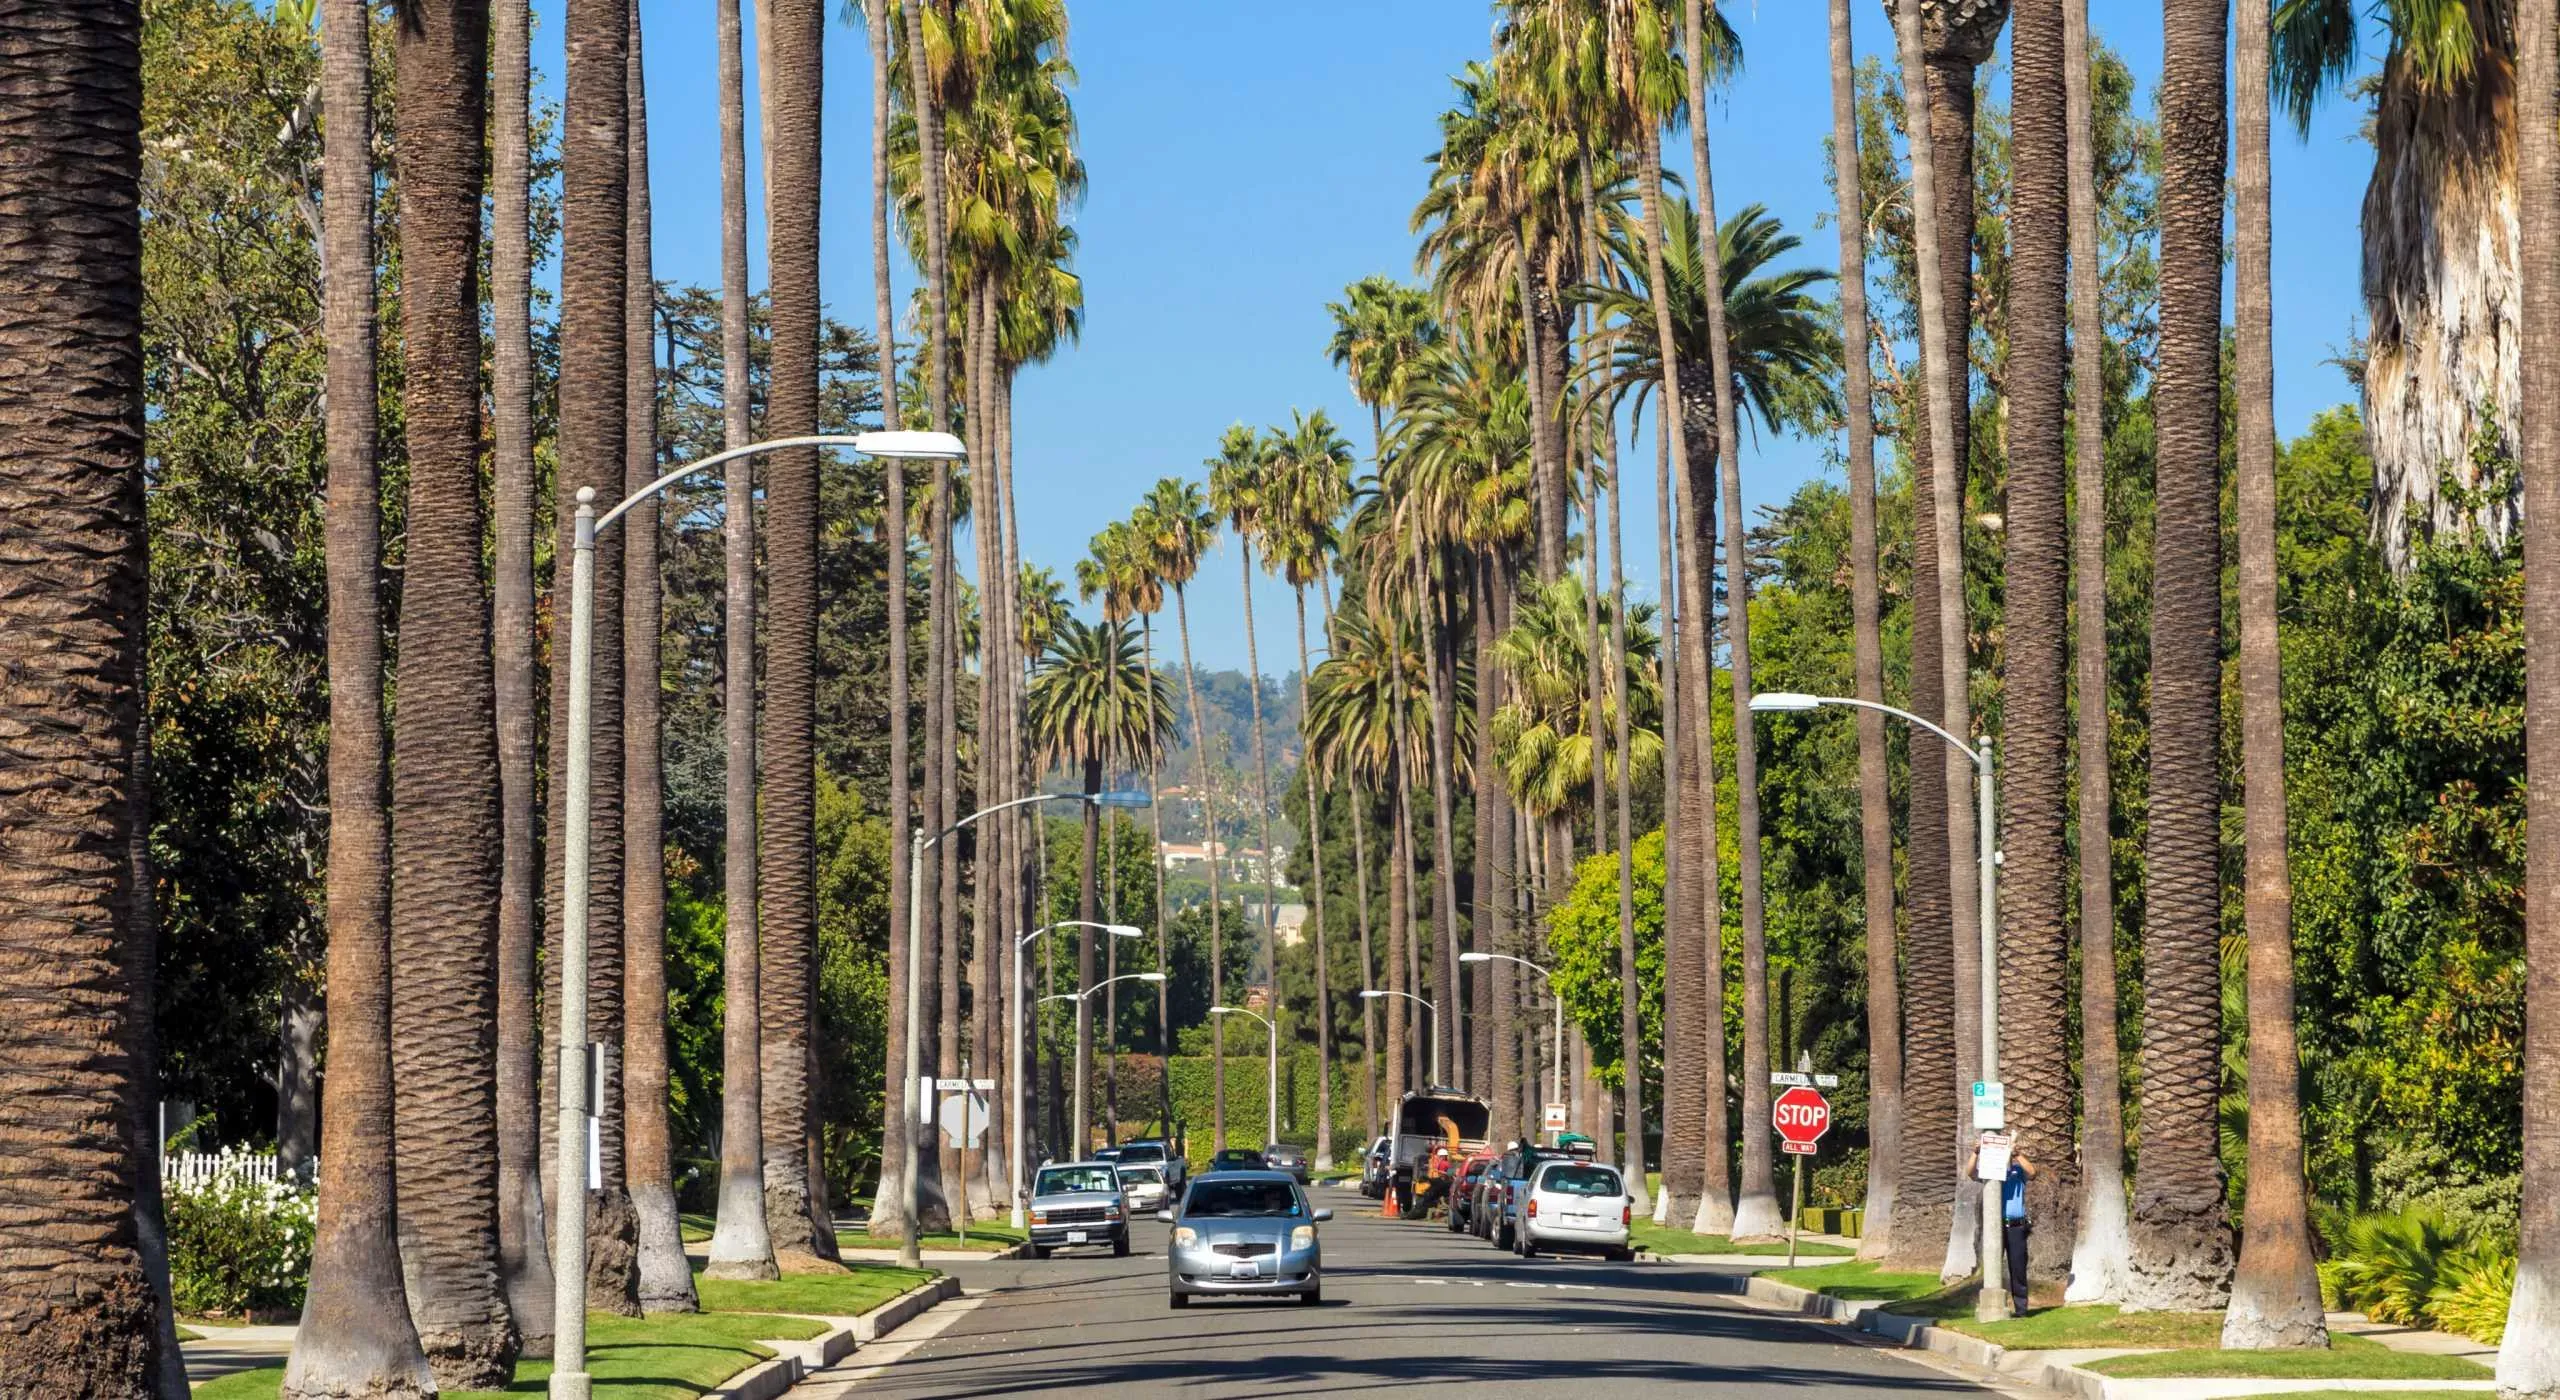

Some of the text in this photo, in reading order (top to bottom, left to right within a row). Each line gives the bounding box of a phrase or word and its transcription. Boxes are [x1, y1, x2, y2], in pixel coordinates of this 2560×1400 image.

[1976, 1084, 1983, 1095] 2
[1778, 1104, 1825, 1126] STOP
[1786, 1143, 1814, 1152] ALL WAY
